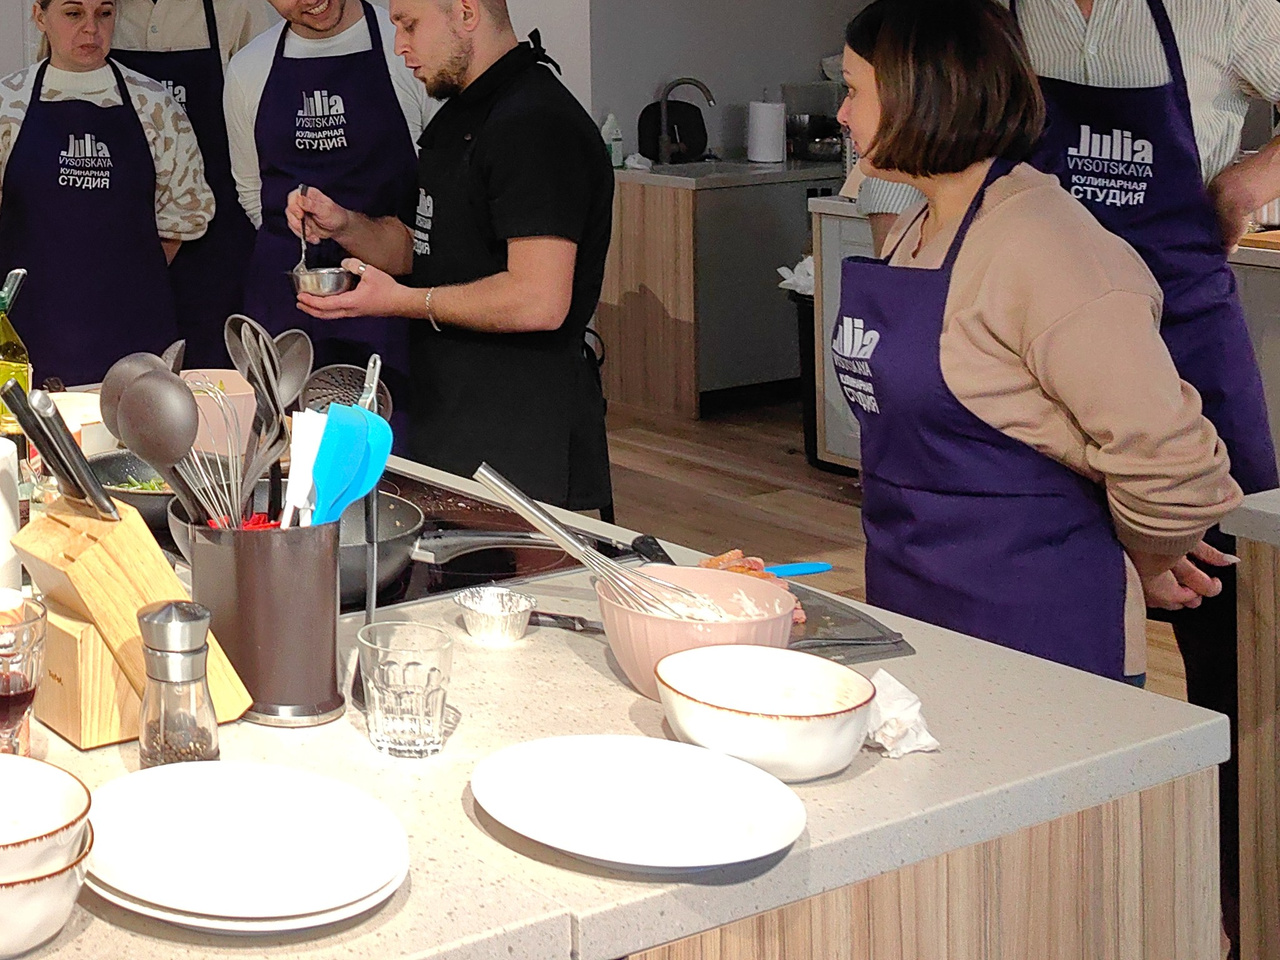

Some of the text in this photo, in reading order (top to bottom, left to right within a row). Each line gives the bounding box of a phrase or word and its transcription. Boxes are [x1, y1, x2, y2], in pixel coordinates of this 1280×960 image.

[297, 90, 345, 116] Julia
[60, 133, 111, 158] Julia
[295, 136, 348, 151] СТУДИЯ
[1067, 124, 1154, 164] Julia
[58, 156, 114, 168] VYSOTSKAYA
[1066, 156, 1153, 178] VYSOTSKAYA
[60, 167, 110, 177] КУЛИНАРНАЯ
[58, 175, 110, 190] СТУДИЯ
[1071, 174, 1148, 191] КУЛИНАРНАЯ
[1070, 185, 1146, 207] СТУДИЯ
